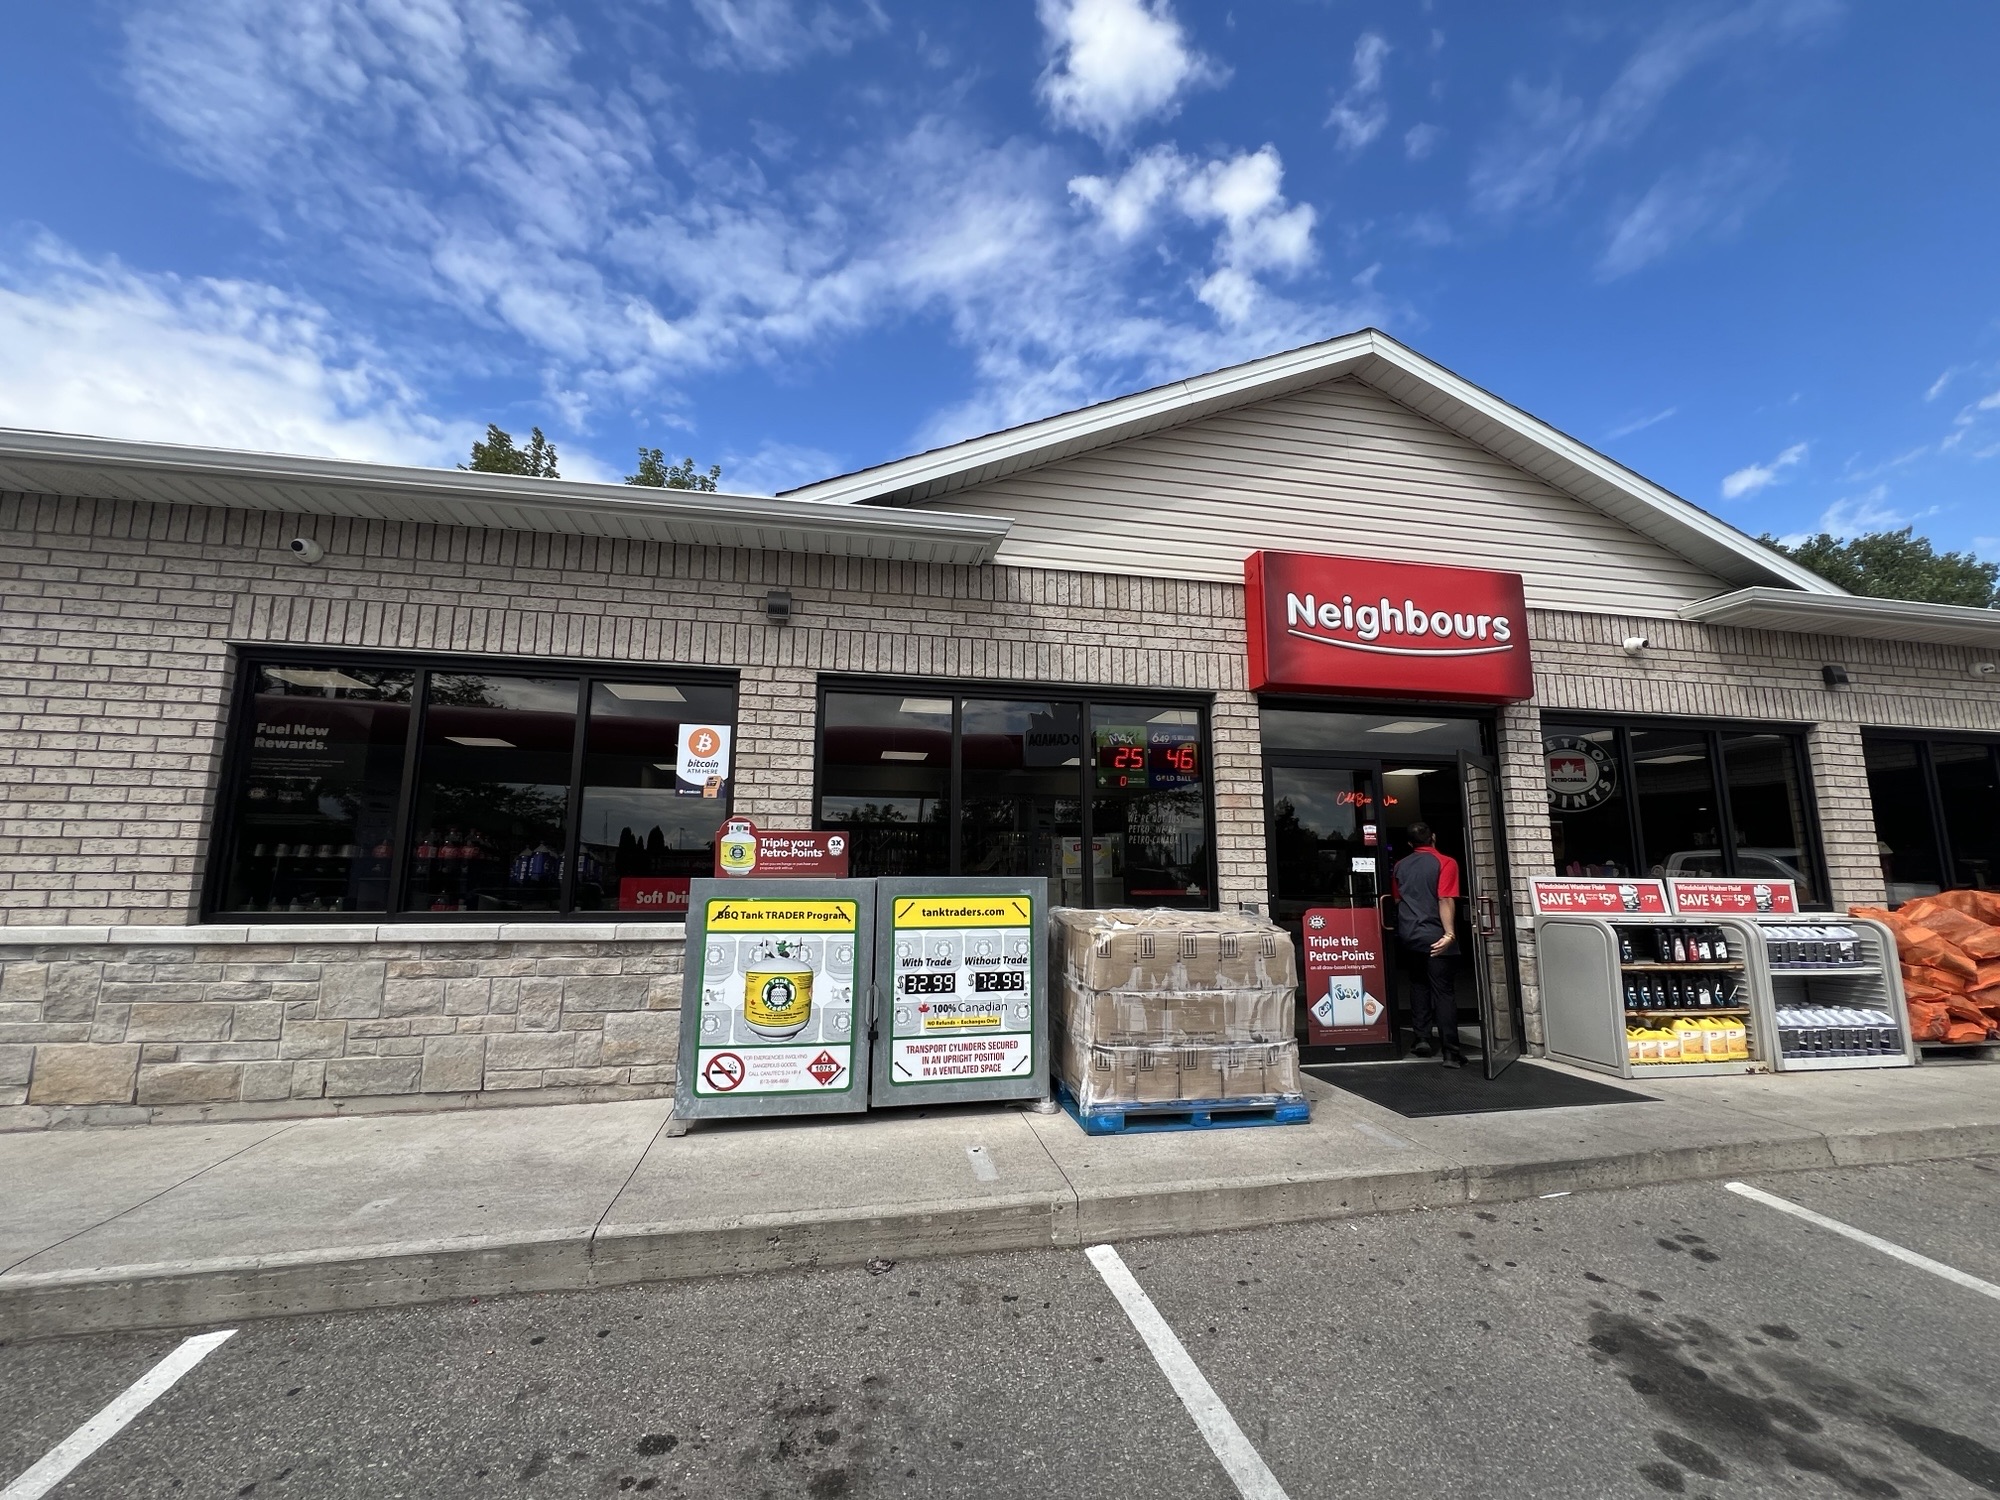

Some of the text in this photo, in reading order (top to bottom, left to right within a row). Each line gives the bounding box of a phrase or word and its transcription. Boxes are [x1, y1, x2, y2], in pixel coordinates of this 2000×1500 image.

[1286, 592, 1511, 642] Neighbours
[257, 723, 329, 736] Fuel New
[254, 737, 328, 750] Rewards.
[1545, 738, 1604, 761] ETRO
[687, 759, 719, 768] bitcoin
[1114, 747, 1143, 768] 25
[1166, 749, 1193, 769] 46
[1120, 775, 1127, 786] 0
[1547, 779, 1611, 808] OINTS
[760, 838, 815, 850] Triple your
[760, 848, 824, 858] Petro-Points
[636, 890, 664, 904] Soft
[1540, 892, 1573, 906] SAVE
[1573, 892, 1587, 905] $4
[1679, 893, 1710, 906] SAVE
[1710, 894, 1723, 906] $4
[717, 910, 847, 922] BBQ Tank TRADER Program
[922, 907, 1005, 917] tanktraders.com
[1308, 936, 1358, 948] Triple the
[902, 957, 952, 967] With Trade
[965, 955, 1028, 966] Without Trade
[1309, 951, 1375, 962] Petro-Points
[907, 974, 954, 993] 32.99
[978, 972, 1023, 990] 72.99
[932, 1002, 1008, 1014] 100% Canadian
[961, 1018, 986, 1026] Exchanges
[906, 1040, 1018, 1054] TRANSPORT CYLINDERS SECURED
[922, 1052, 1005, 1065] IN AN UPRIGHT POSITION
[923, 1064, 1002, 1076] IN A VENTILATED SPACE
